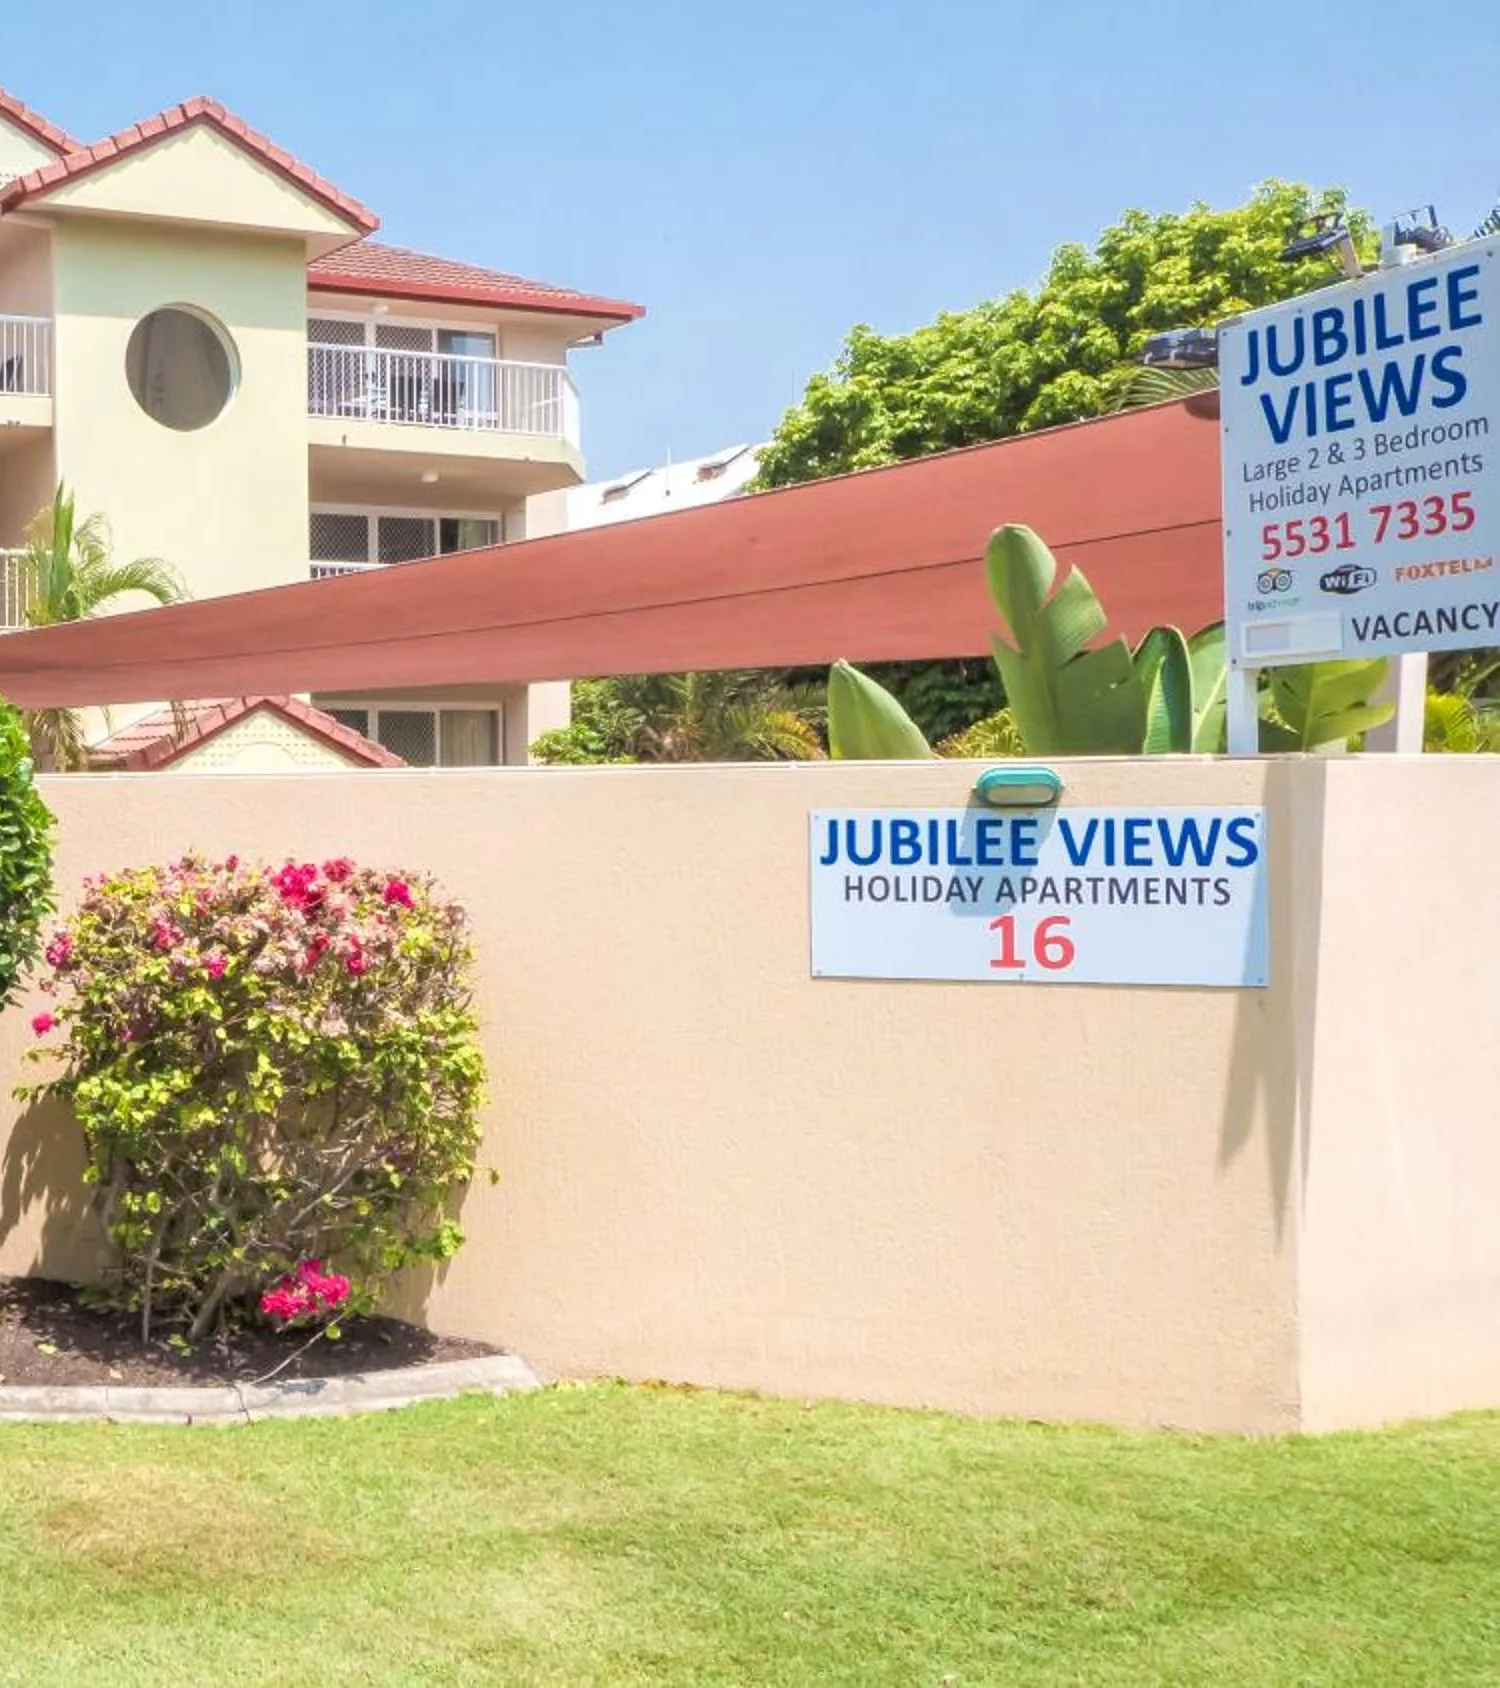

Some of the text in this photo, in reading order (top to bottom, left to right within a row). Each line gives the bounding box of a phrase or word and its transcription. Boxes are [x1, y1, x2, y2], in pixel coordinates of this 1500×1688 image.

[1241, 265, 1482, 386] JUBILEE
[1260, 345, 1467, 444] VIEWS
[1243, 417, 1489, 482] Large 2 & 3 Bedroom
[1249, 453, 1483, 512] Holiday Apartments
[1262, 491, 1476, 560] 5531 7335
[1351, 602, 1500, 642] VACANCY
[820, 816, 1259, 868] JUBILEE VIEWS
[845, 875, 1231, 906] HOLIDAY APARTMENTS
[988, 915, 1075, 971] 16
